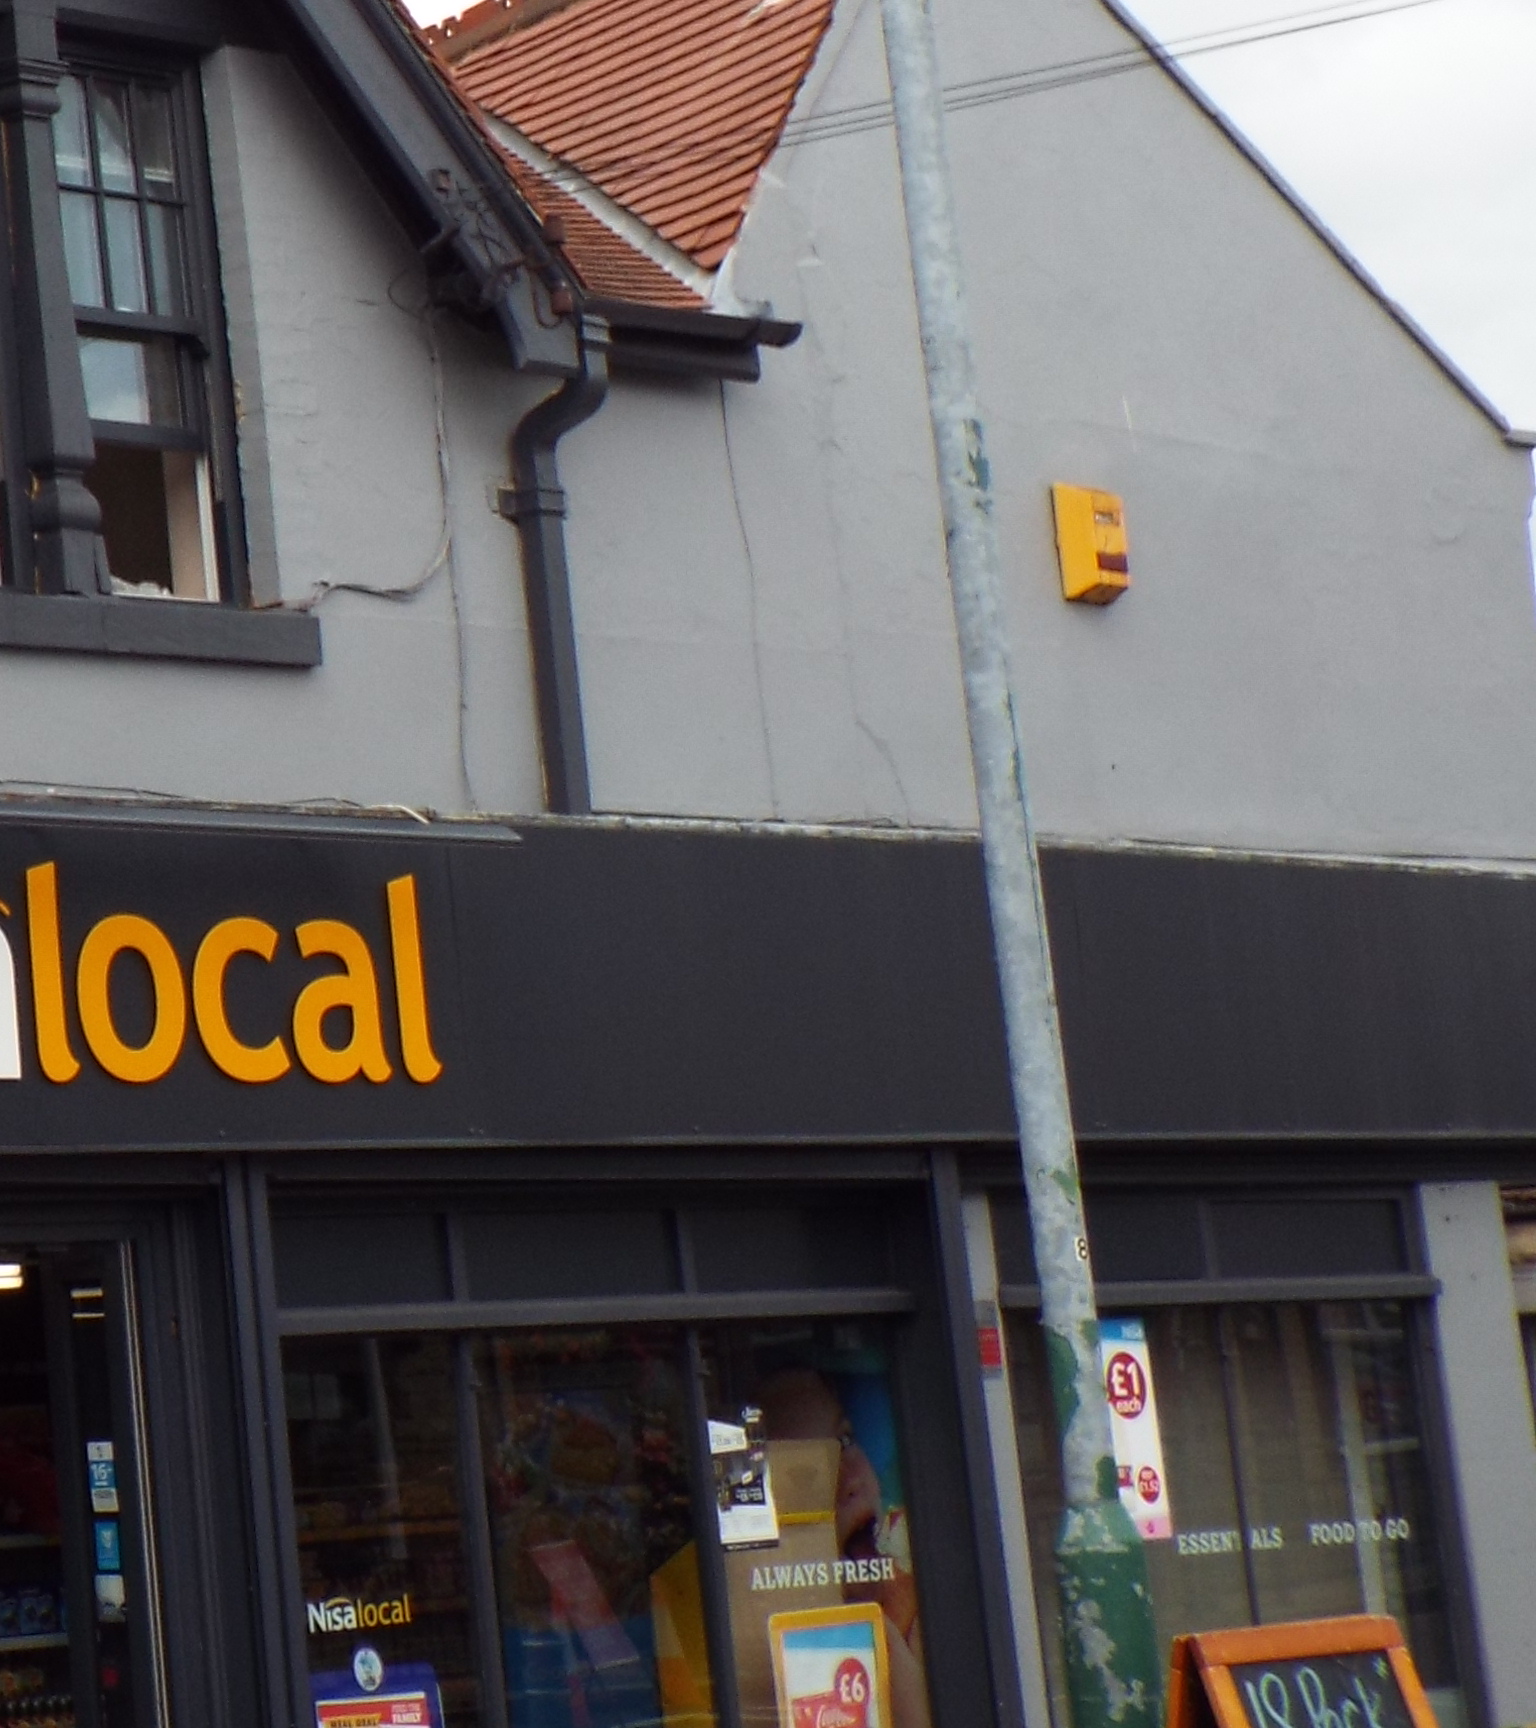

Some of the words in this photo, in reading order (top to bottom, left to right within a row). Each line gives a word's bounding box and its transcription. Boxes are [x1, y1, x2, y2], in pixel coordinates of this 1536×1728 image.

[1111, 1361, 1141, 1398] £1
[1178, 1528, 1283, 1556] ESSENTALS
[1309, 1522, 1356, 1546] FOOD
[1385, 1519, 1410, 1540] GO
[751, 1562, 829, 1592] ALWAYS
[832, 1556, 896, 1585] FRESH
[840, 1672, 866, 1704] £6
